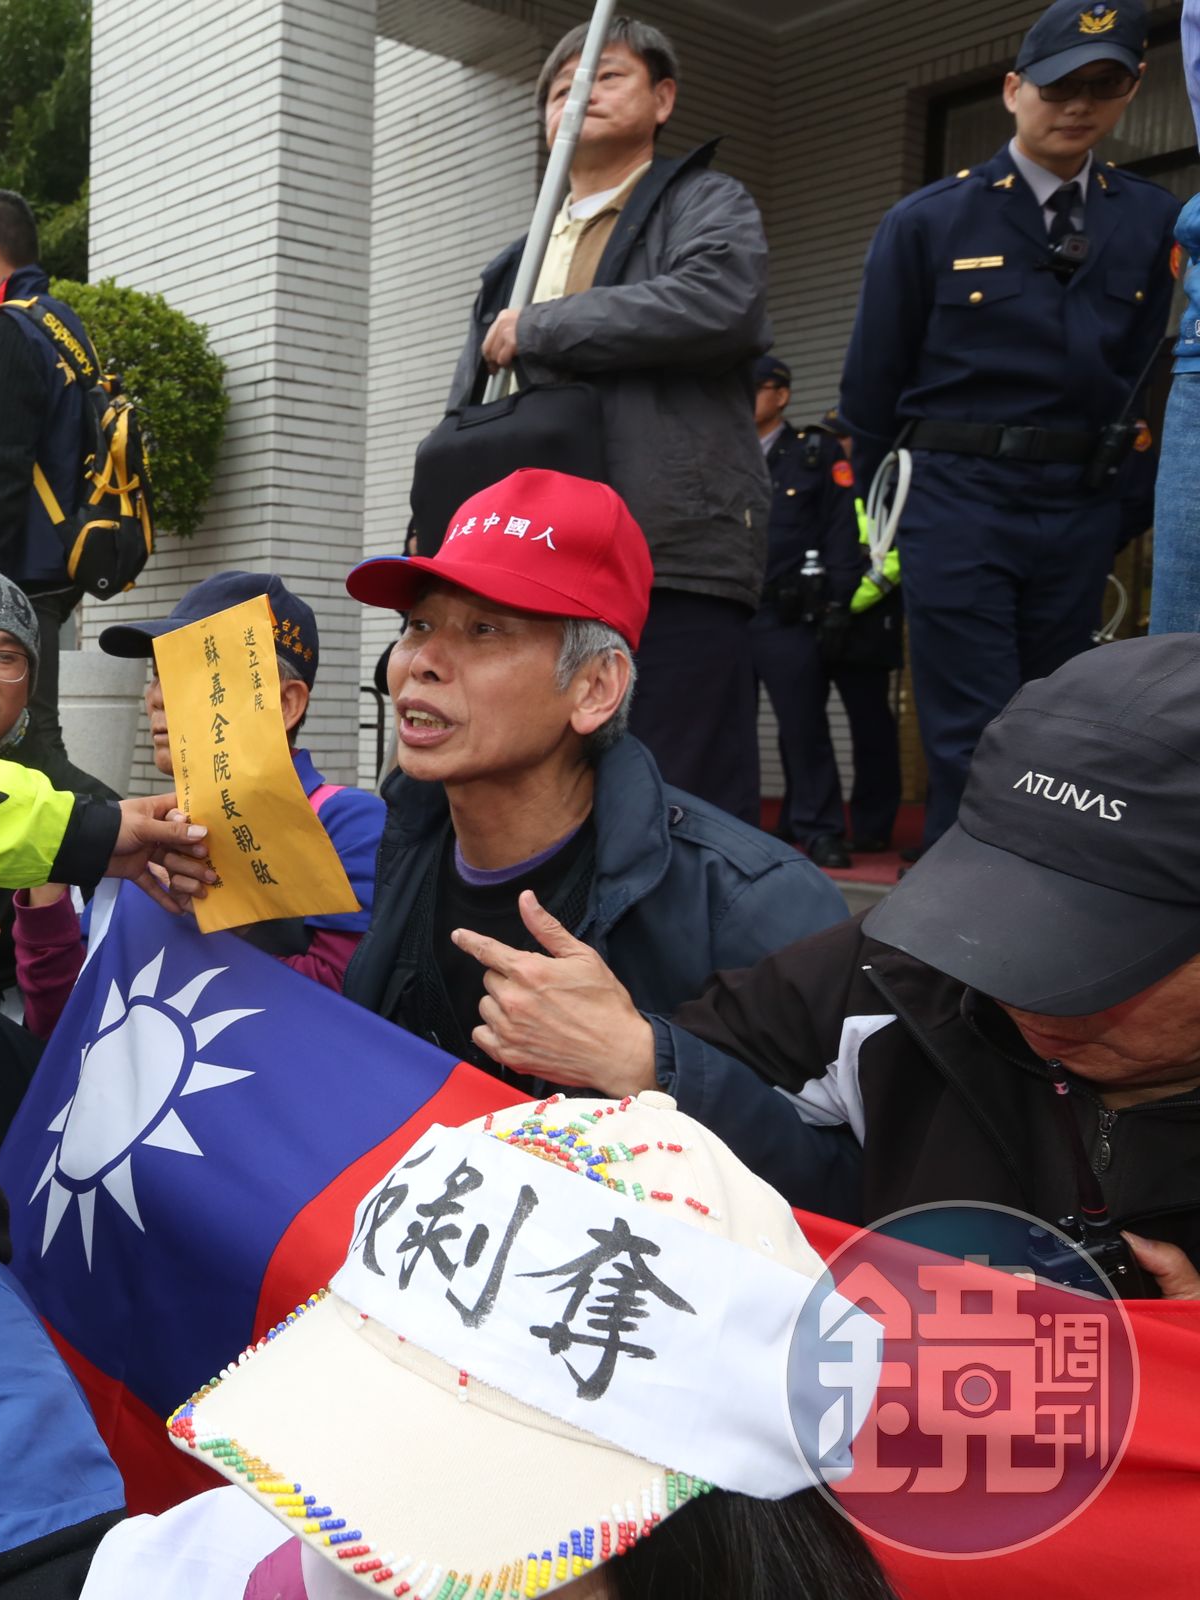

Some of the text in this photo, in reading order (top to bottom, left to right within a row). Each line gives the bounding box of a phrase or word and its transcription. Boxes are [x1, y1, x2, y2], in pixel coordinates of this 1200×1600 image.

[243, 626, 265, 712] 送立法院
[1012, 770, 1127, 821] ATUNAS
